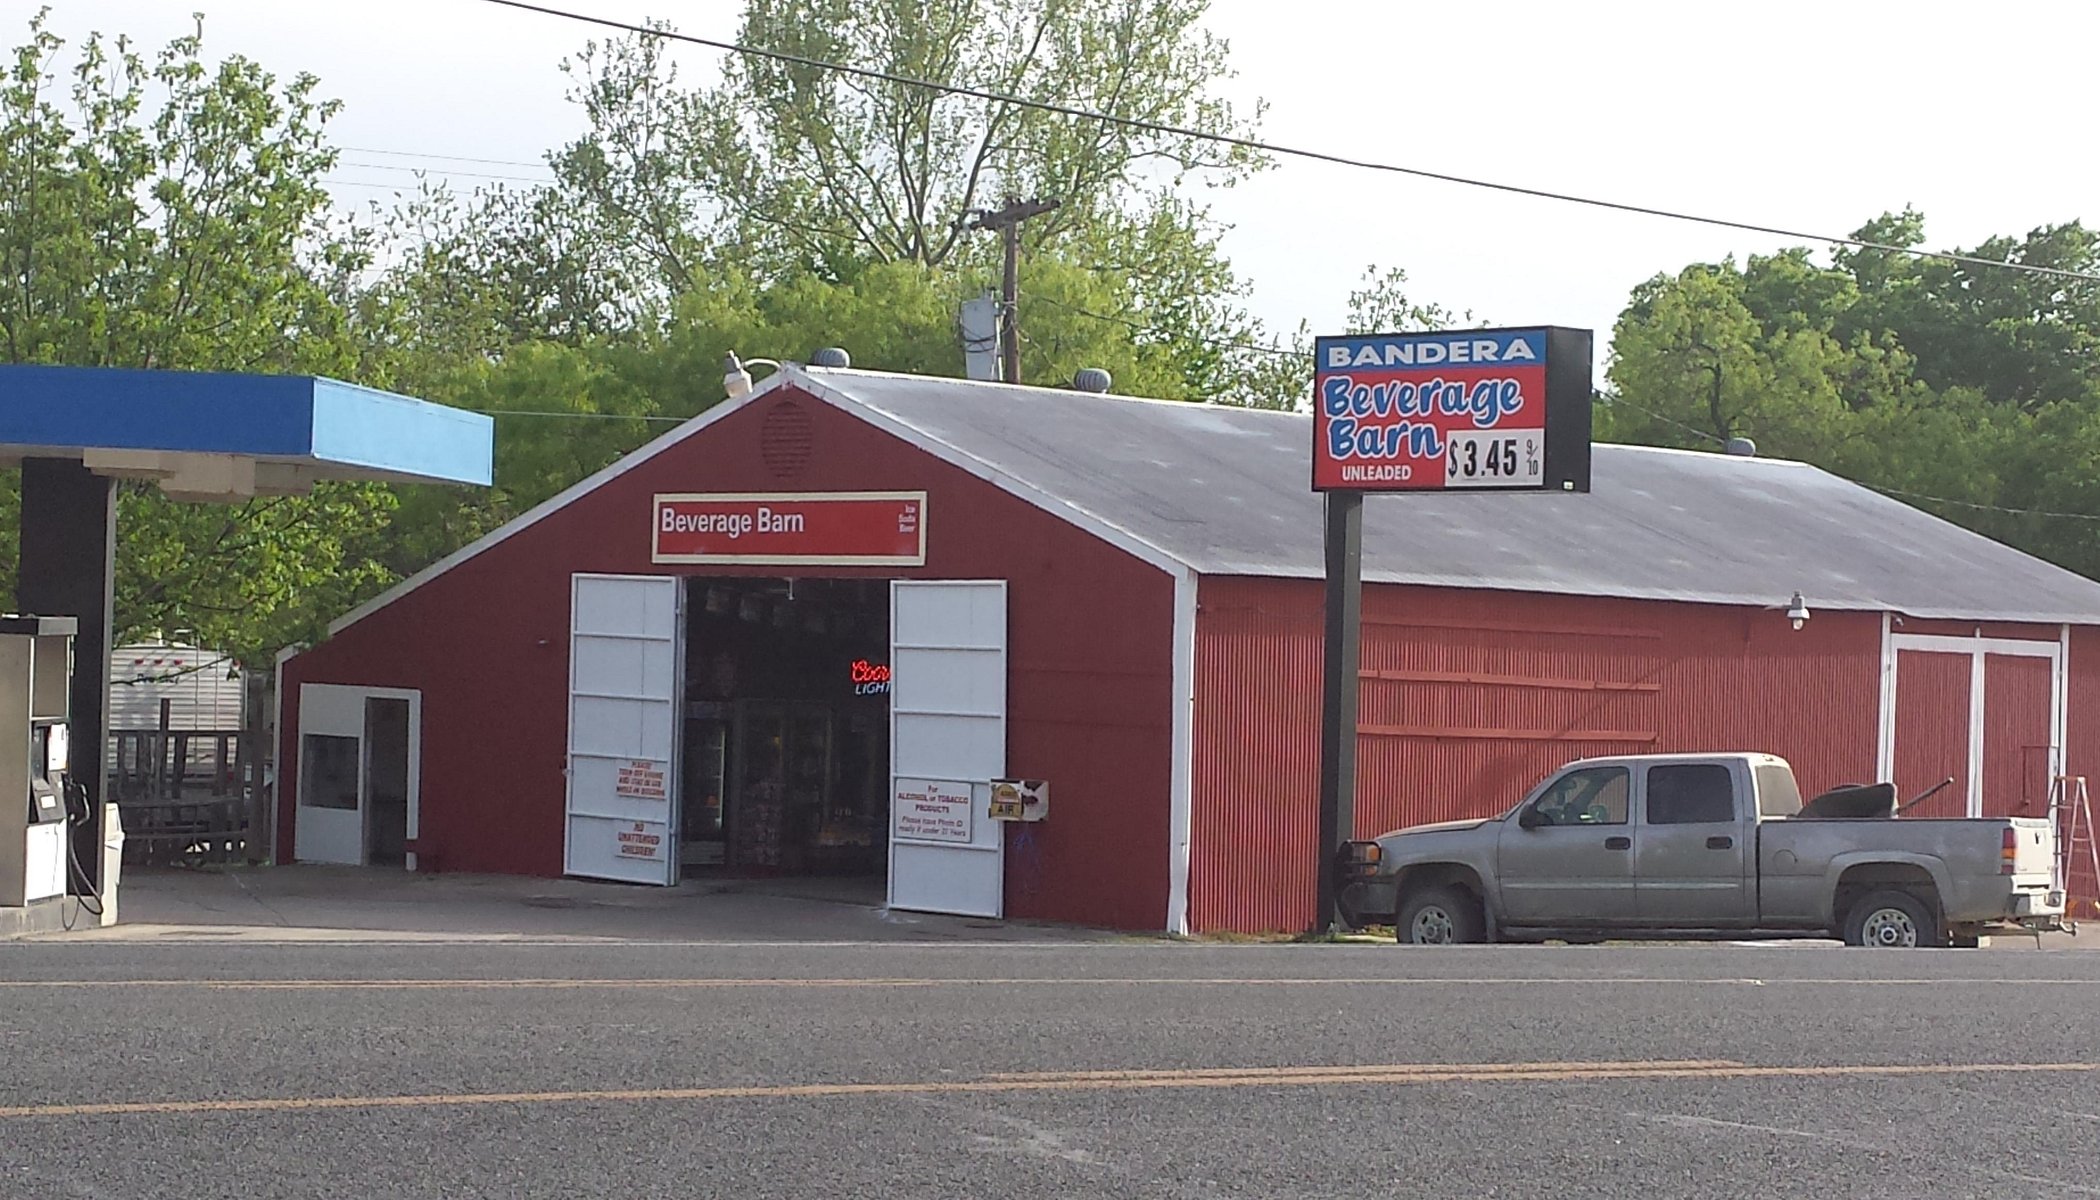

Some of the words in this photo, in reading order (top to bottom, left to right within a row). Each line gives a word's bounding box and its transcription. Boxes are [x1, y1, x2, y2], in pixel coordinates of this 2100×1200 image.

[1328, 338, 1536, 368] BANDERA
[1322, 375, 1523, 429] Beverage
[1327, 416, 1444, 460] Barn
[1341, 464, 1412, 481] UNLEADED
[661, 507, 752, 538] Beverage
[757, 507, 804, 532] Barn
[851, 659, 890, 682] Coor
[855, 681, 890, 695] LIGHT
[898, 792, 928, 802] ALCOHOL
[938, 795, 969, 804] TOBACCO
[915, 804, 949, 813] PRODUCTS
[998, 805, 1014, 816] AIR
